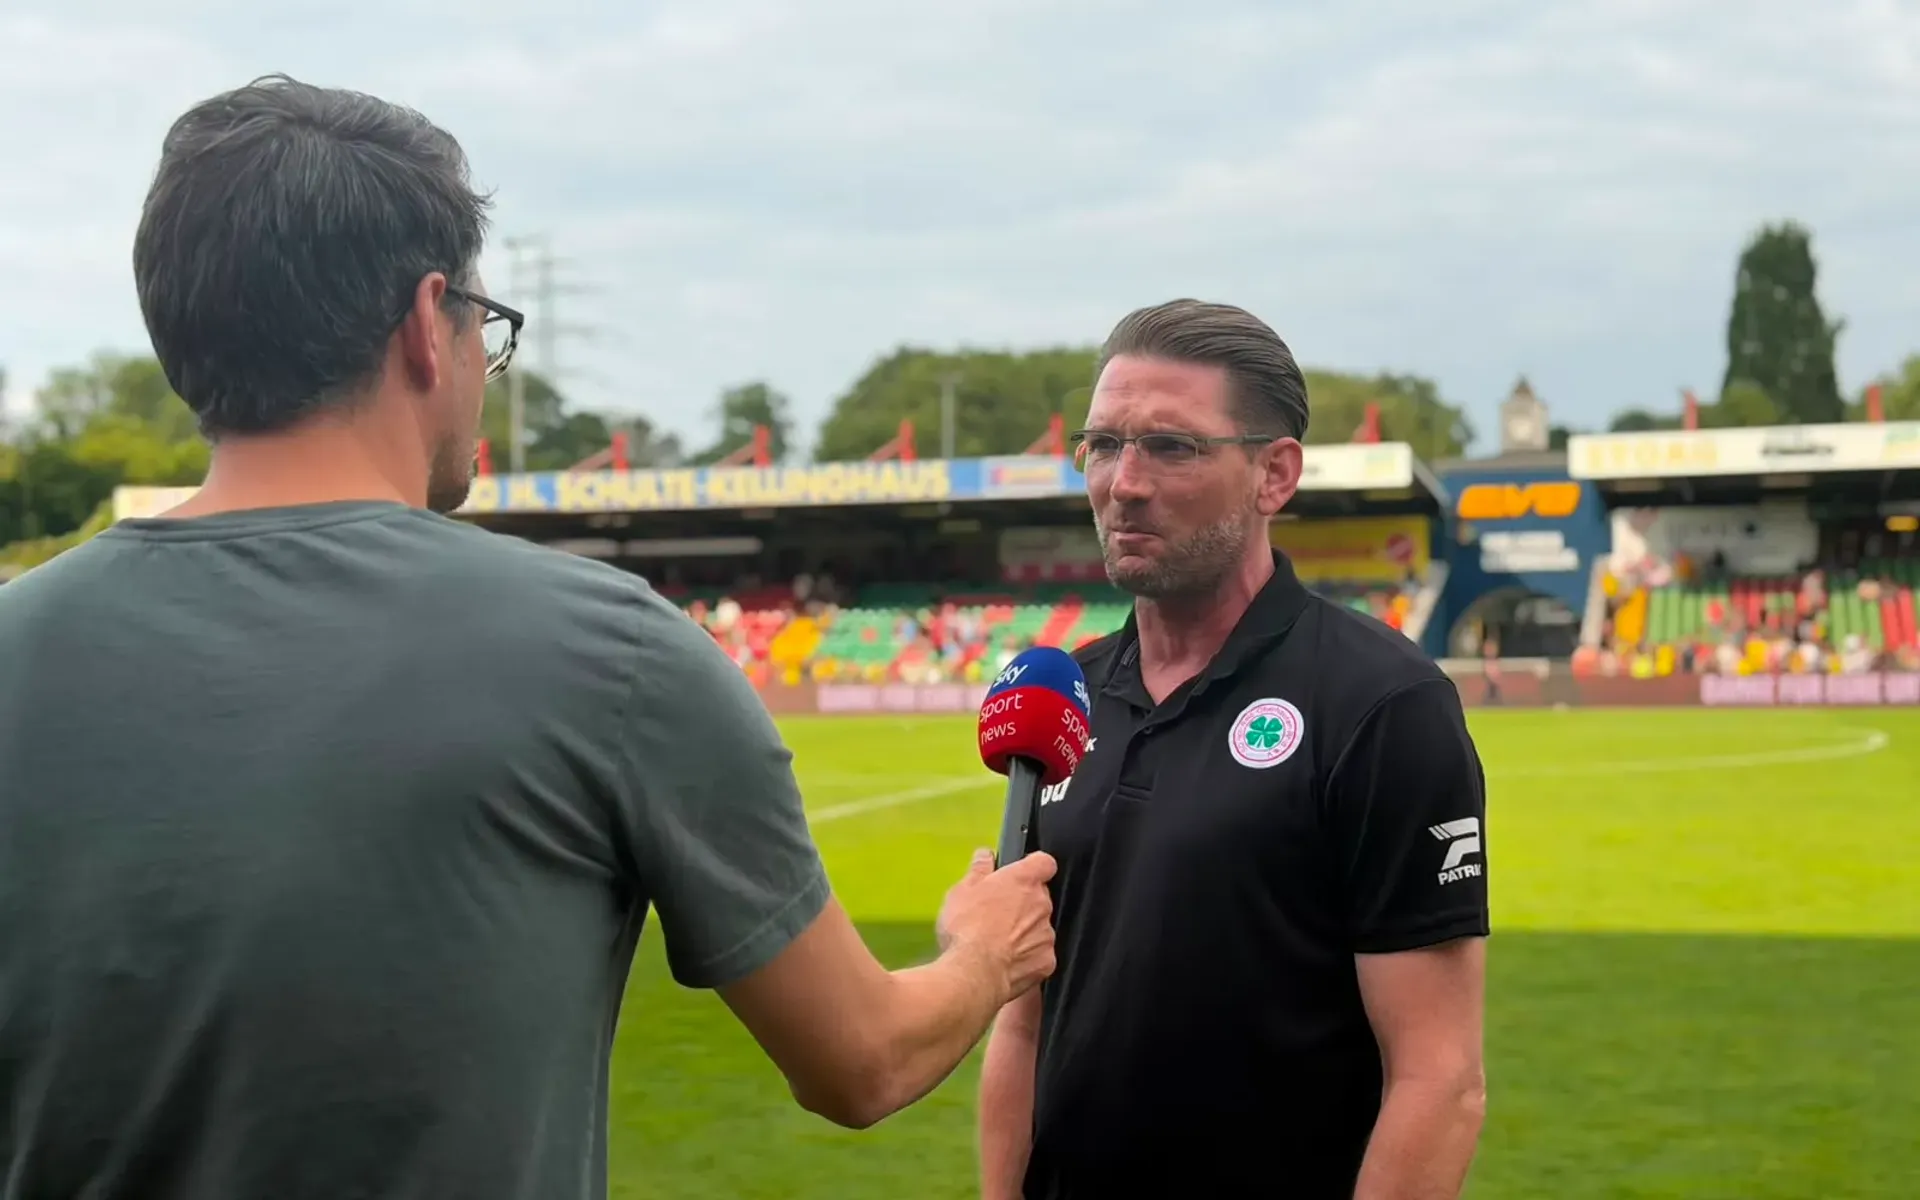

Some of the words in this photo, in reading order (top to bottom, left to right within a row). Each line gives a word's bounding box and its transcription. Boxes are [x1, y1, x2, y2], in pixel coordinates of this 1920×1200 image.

[993, 664, 1028, 688] sky
[980, 693, 1024, 723] sport
[981, 722, 1017, 745] news
[1061, 708, 1089, 747] spor
[1438, 863, 1481, 885] PATRI
